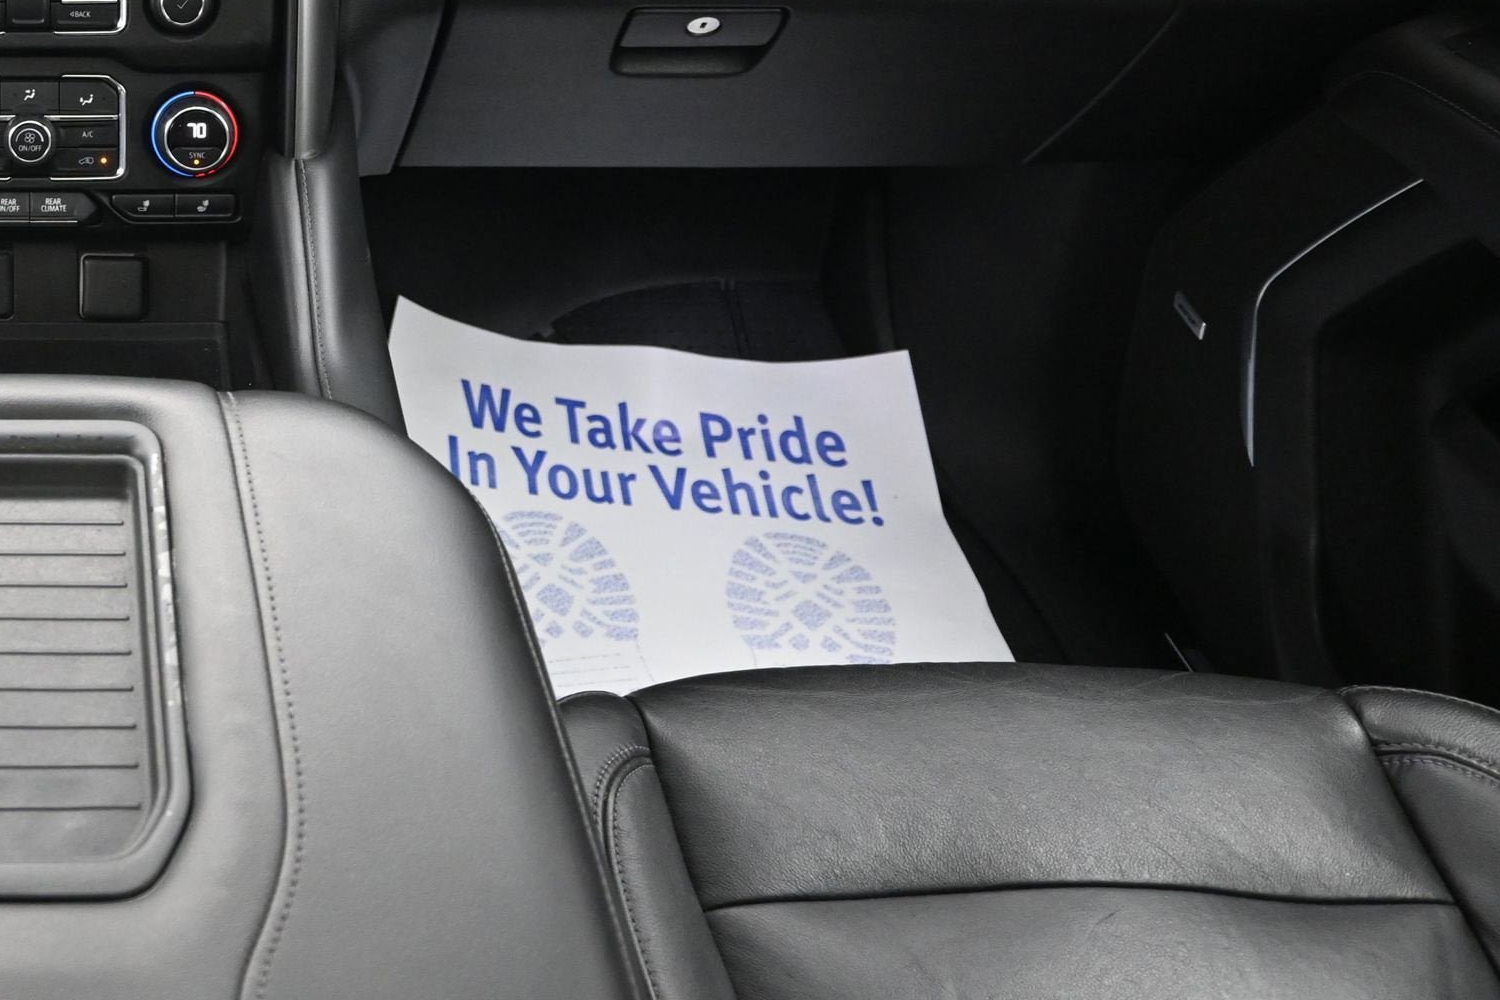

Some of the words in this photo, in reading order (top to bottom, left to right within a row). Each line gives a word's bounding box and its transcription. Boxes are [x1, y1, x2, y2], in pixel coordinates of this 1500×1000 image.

[75, 10, 91, 18] BACK
[82, 130, 93, 138] A/C
[186, 122, 207, 139] 70
[188, 151, 205, 159] SYNC
[41, 205, 67, 213] CLIMATE
[461, 378, 543, 438] We
[554, 396, 681, 457] Take
[699, 411, 847, 467] Pride
[448, 435, 498, 489] In
[511, 445, 636, 506] Your
[648, 464, 885, 527] Vehicle!
